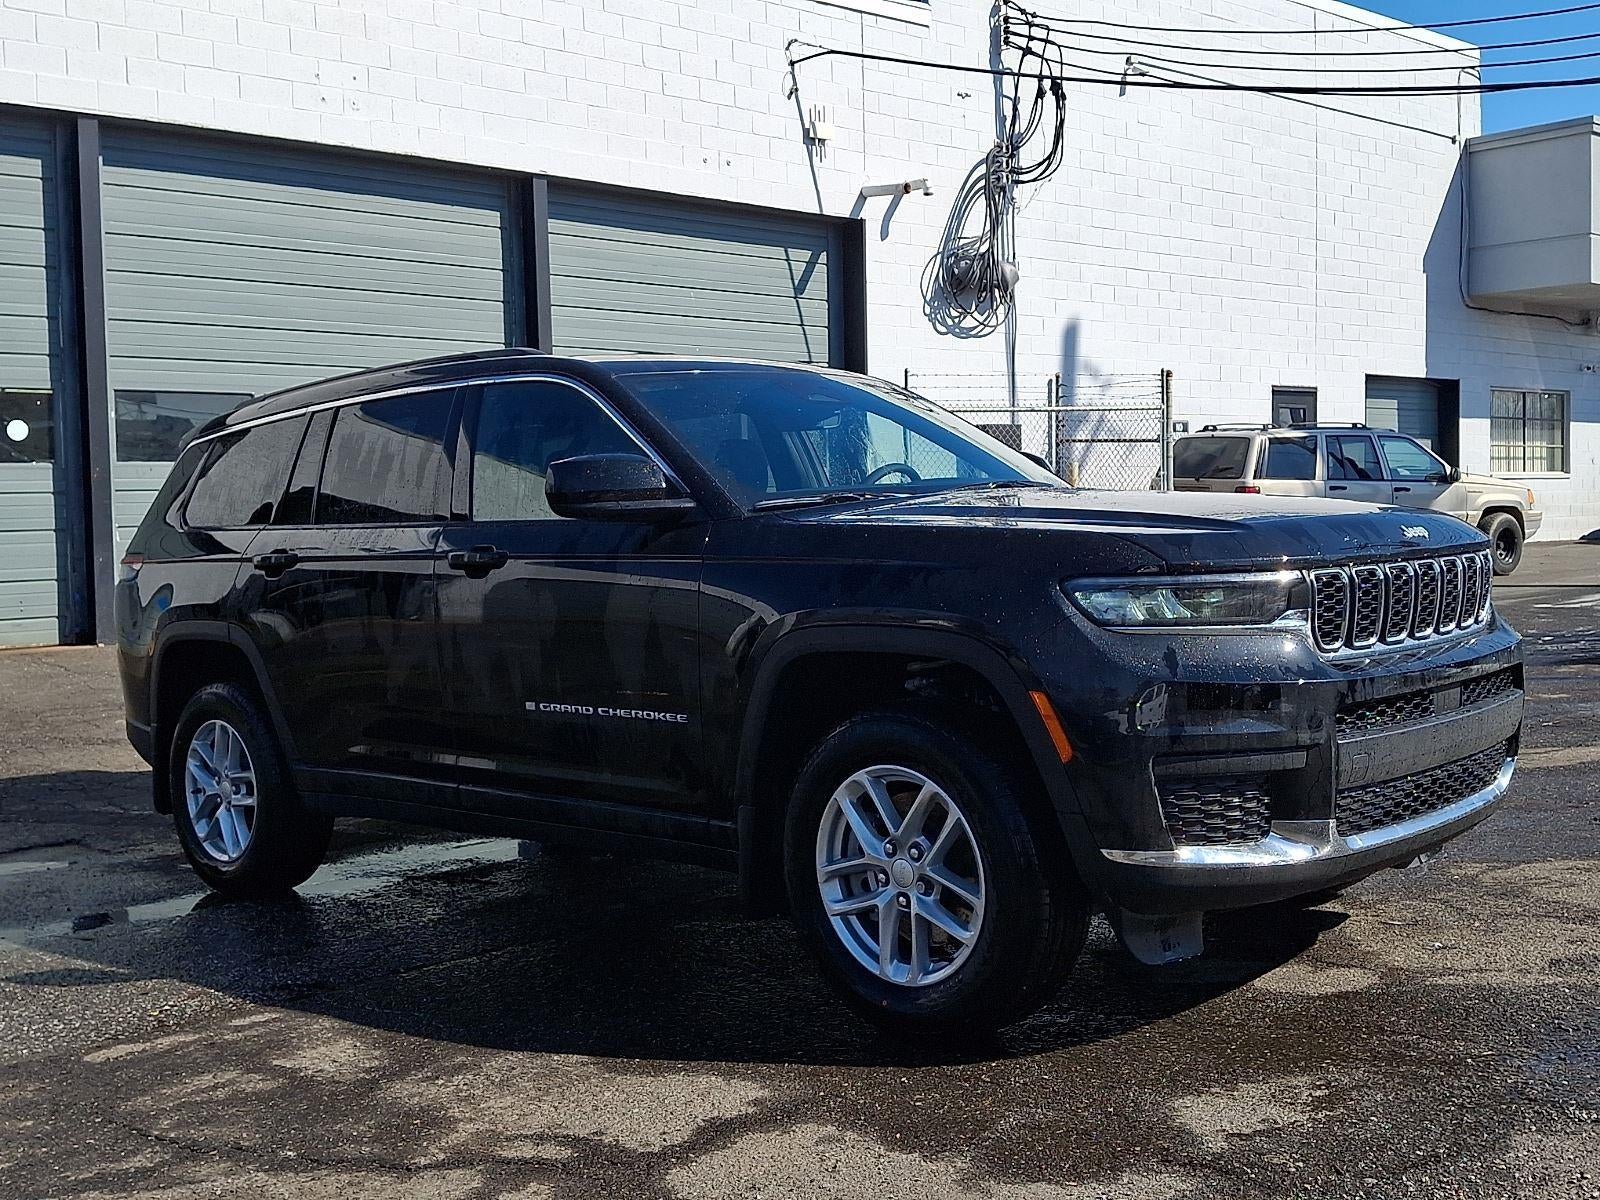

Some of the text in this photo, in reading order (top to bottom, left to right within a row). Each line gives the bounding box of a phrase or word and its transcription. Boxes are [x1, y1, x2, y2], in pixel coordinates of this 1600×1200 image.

[1400, 524, 1430, 541] Jeep
[539, 702, 689, 723] GRAND CHEROKEE
